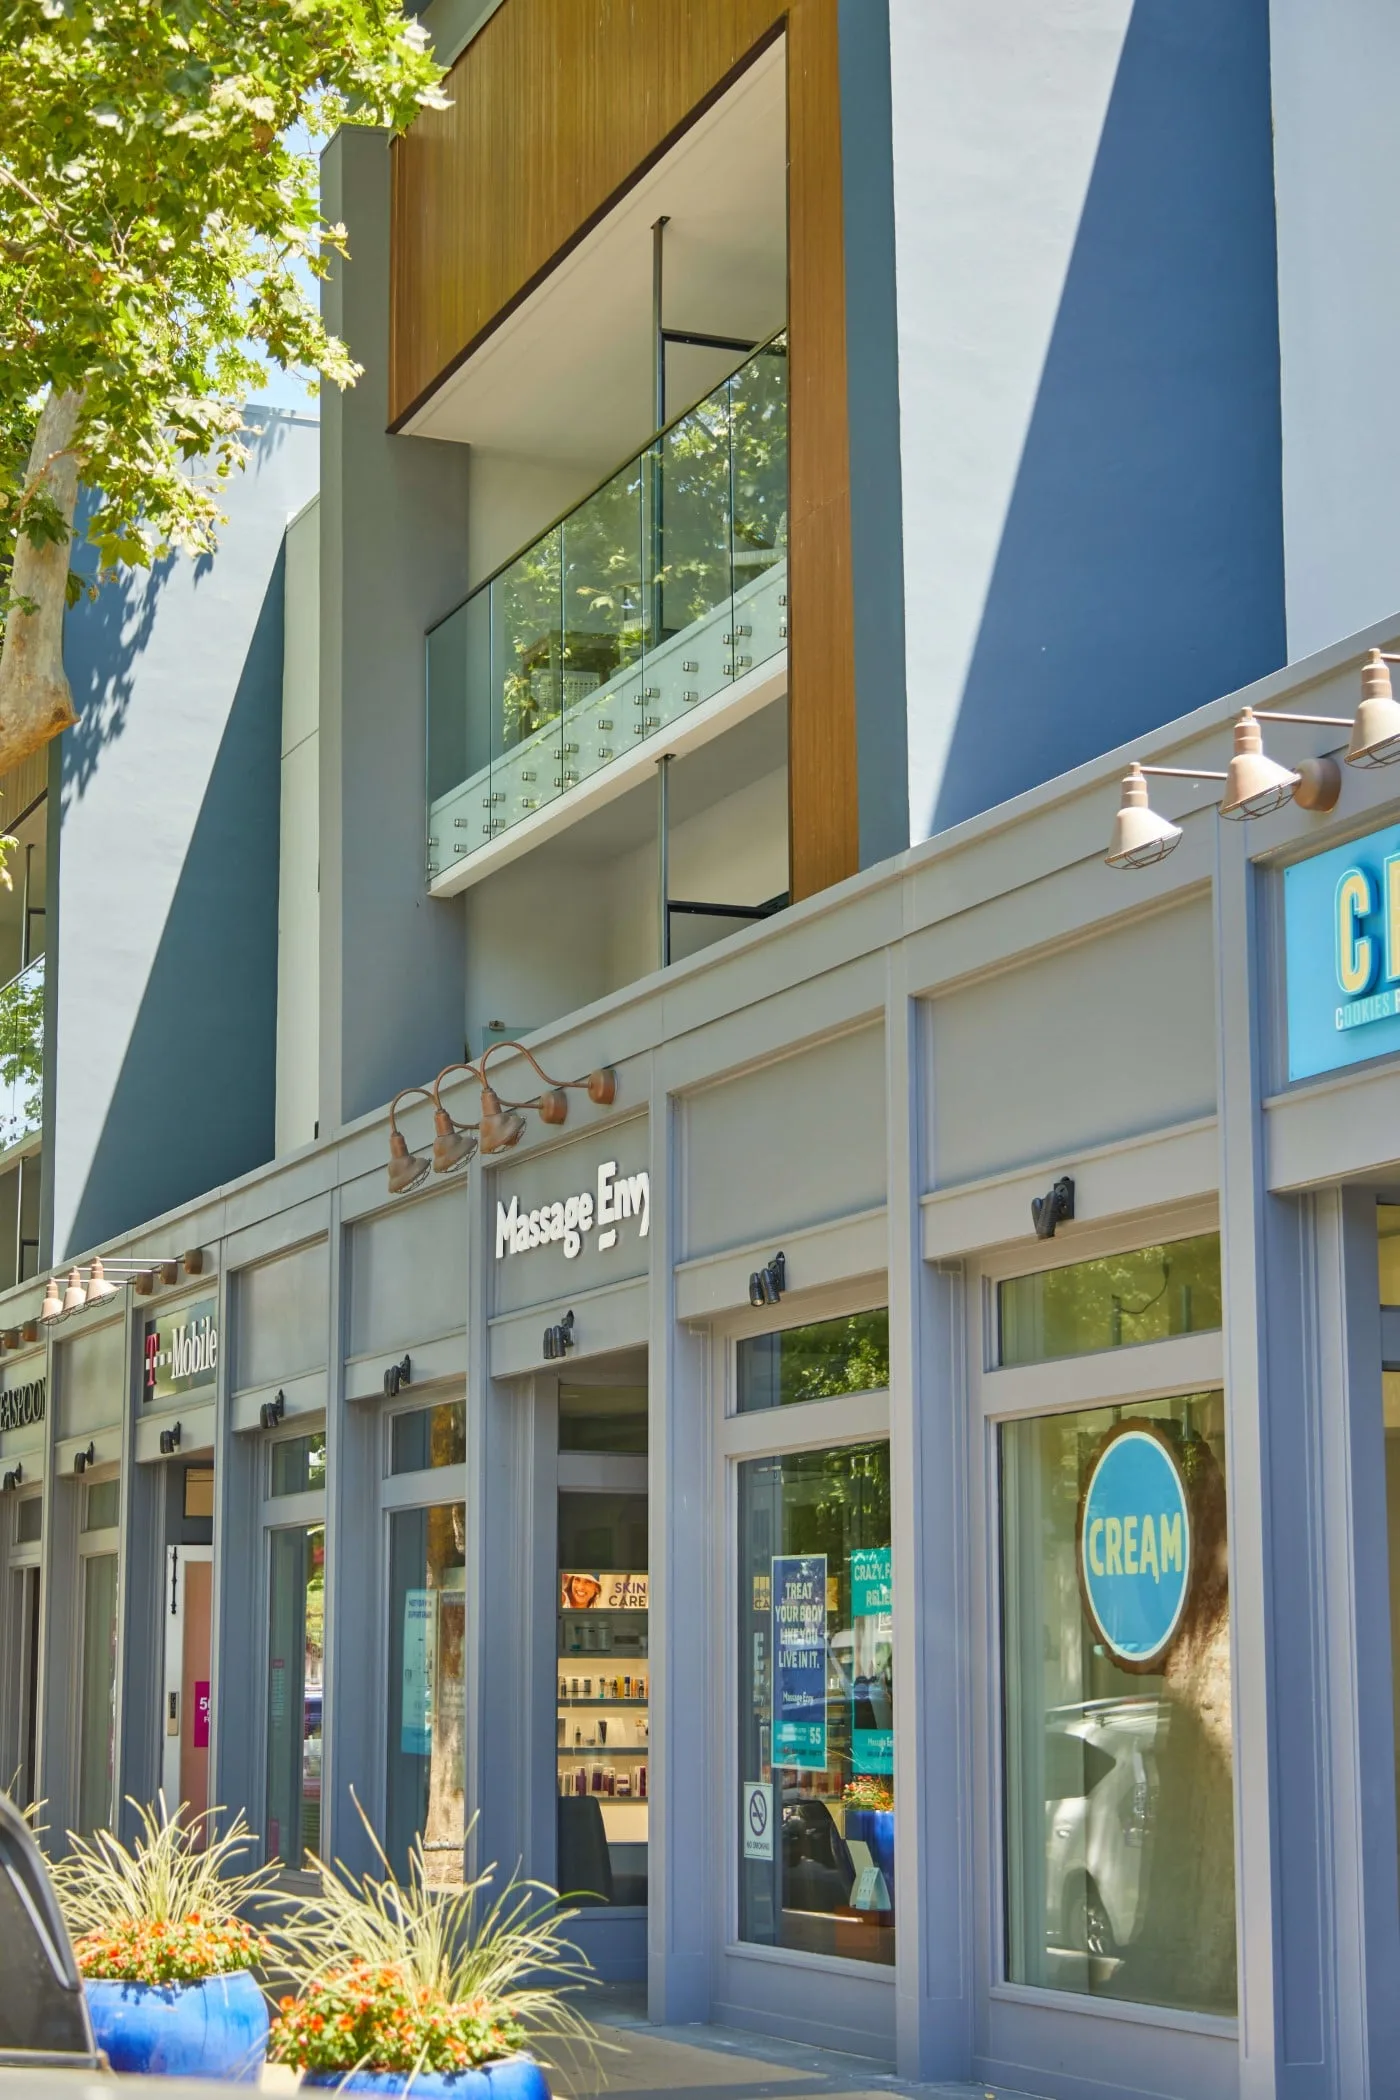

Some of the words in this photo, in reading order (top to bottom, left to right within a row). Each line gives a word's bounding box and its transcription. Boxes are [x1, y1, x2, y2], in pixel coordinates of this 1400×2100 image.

[495, 1192, 594, 1259] Massage
[597, 1160, 650, 1237] Envy
[1088, 1512, 1183, 1585] CREAM
[615, 1582, 646, 1594] SKIN
[785, 1582, 813, 1600] TREAT
[609, 1595, 646, 1607] CARE
[775, 1605, 799, 1623] YOUR
[800, 1604, 824, 1623] BODY
[778, 1651, 798, 1668] LIVE
[799, 1651, 807, 1668] IN
[809, 1727, 821, 1744] 55
